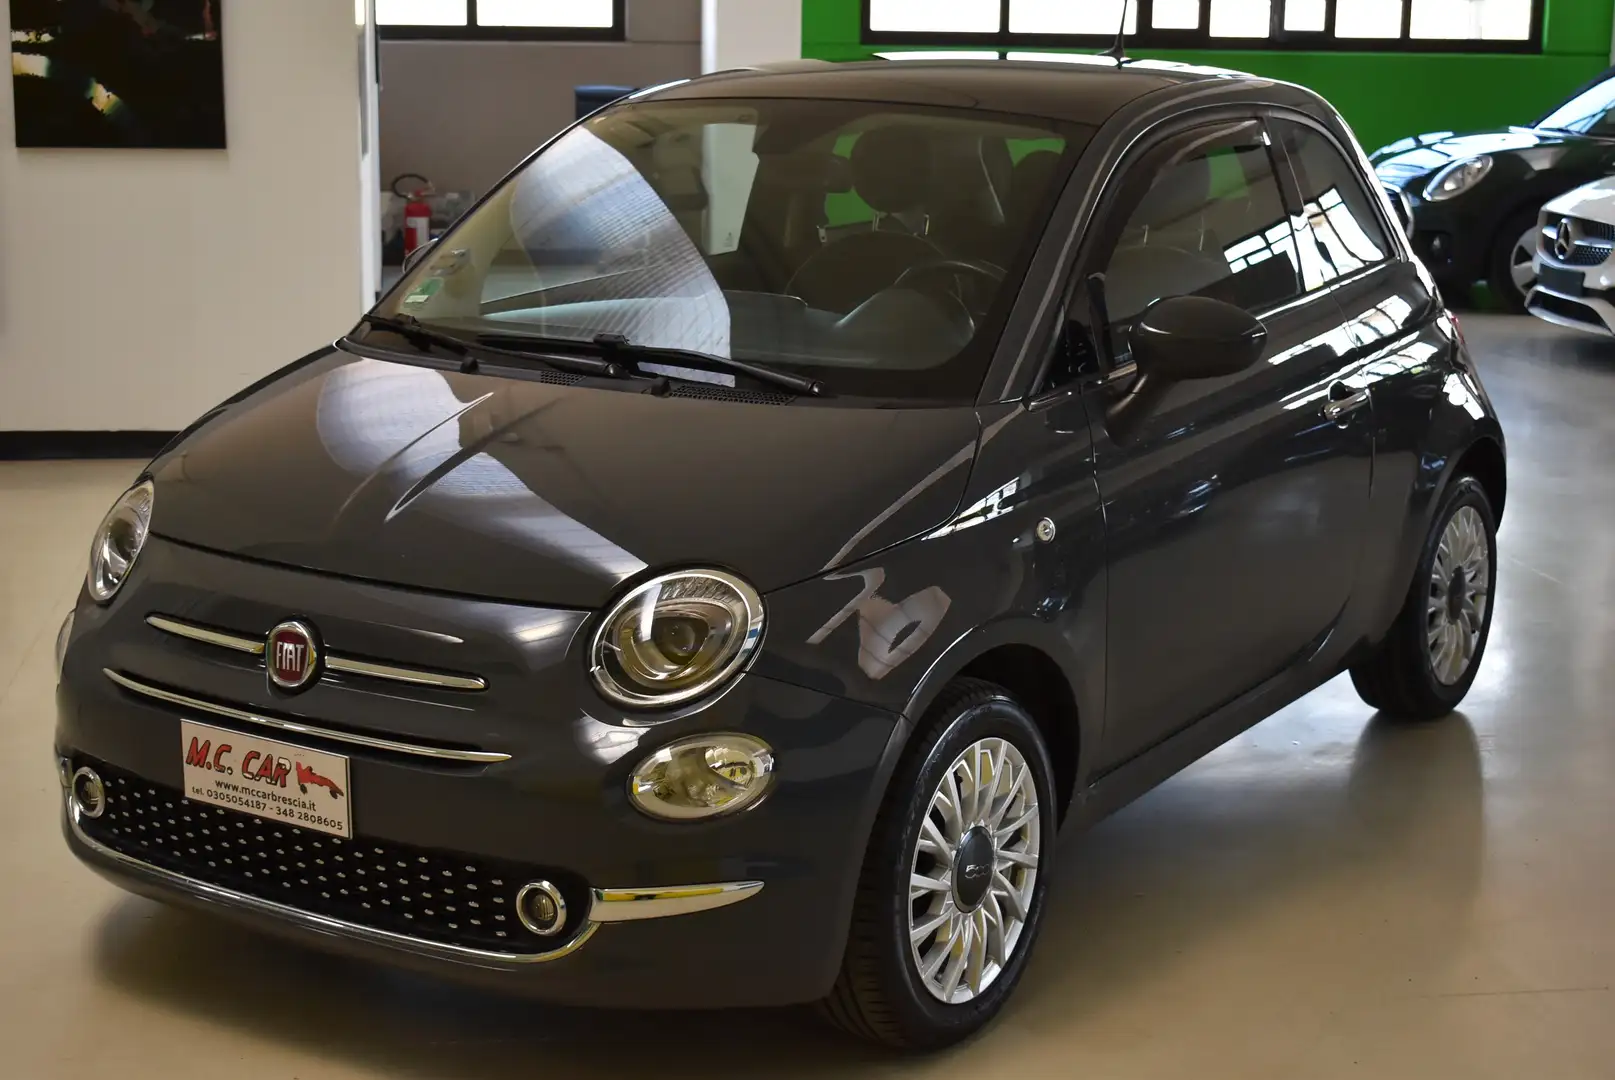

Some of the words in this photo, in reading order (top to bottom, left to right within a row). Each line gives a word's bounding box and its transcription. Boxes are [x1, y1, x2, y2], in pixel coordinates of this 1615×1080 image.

[276, 641, 305, 672] FIAT
[185, 736, 234, 776] M.C.
[241, 750, 292, 788] CAR
[192, 785, 205, 796] tel.
[206, 788, 267, 812] 0305054187
[275, 806, 295, 818] 348
[297, 811, 343, 831] 2808605
[215, 779, 317, 812] www.mccarbrescia.it
